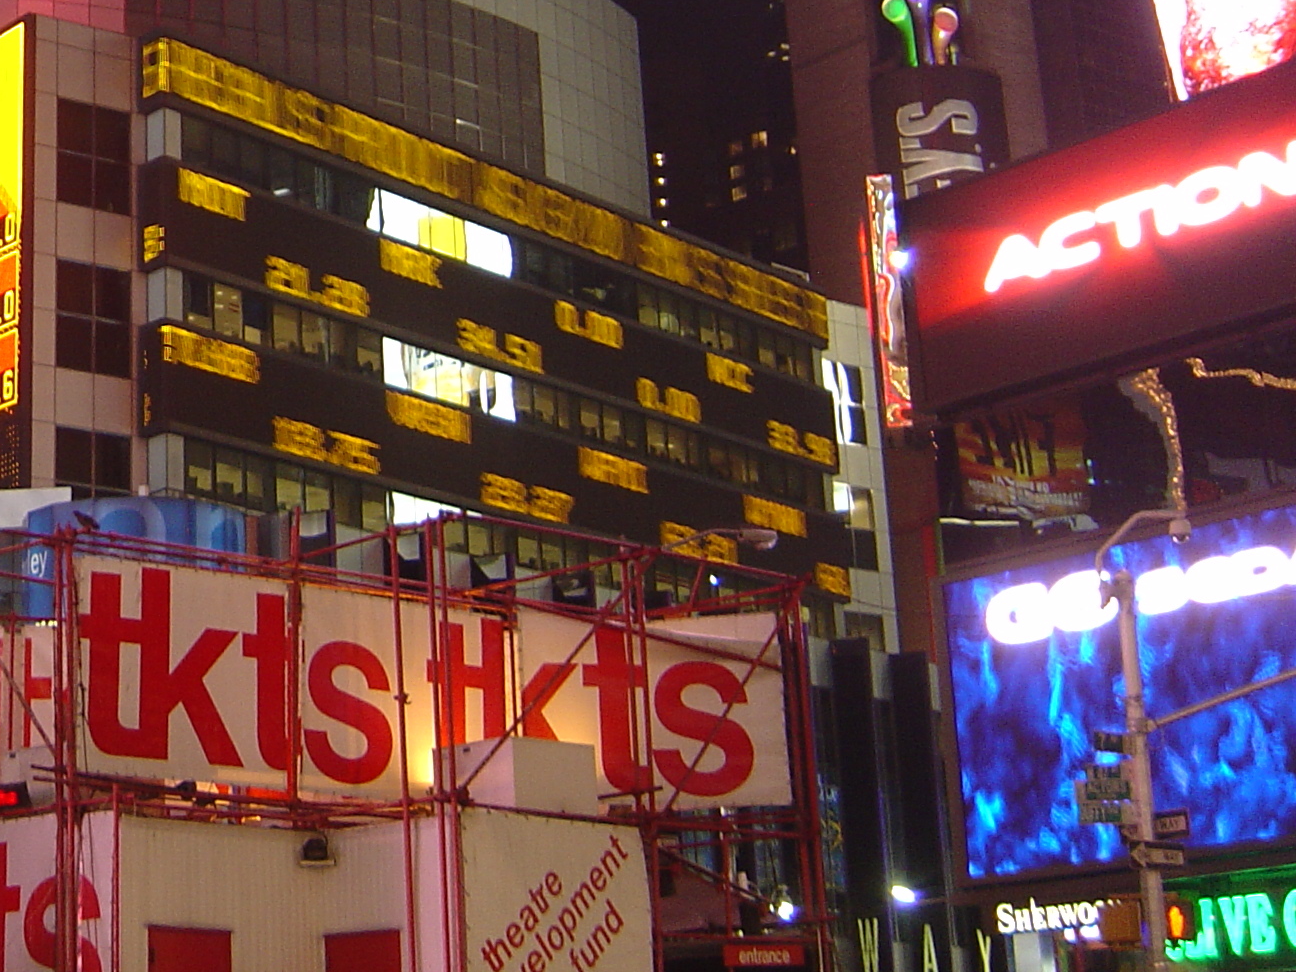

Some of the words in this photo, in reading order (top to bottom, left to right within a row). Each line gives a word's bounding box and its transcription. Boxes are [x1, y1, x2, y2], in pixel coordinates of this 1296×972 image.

[79, 567, 394, 785] tkts
[426, 613, 754, 797] tkts
[570, 898, 624, 972] fund
[738, 945, 791, 966] entrance
